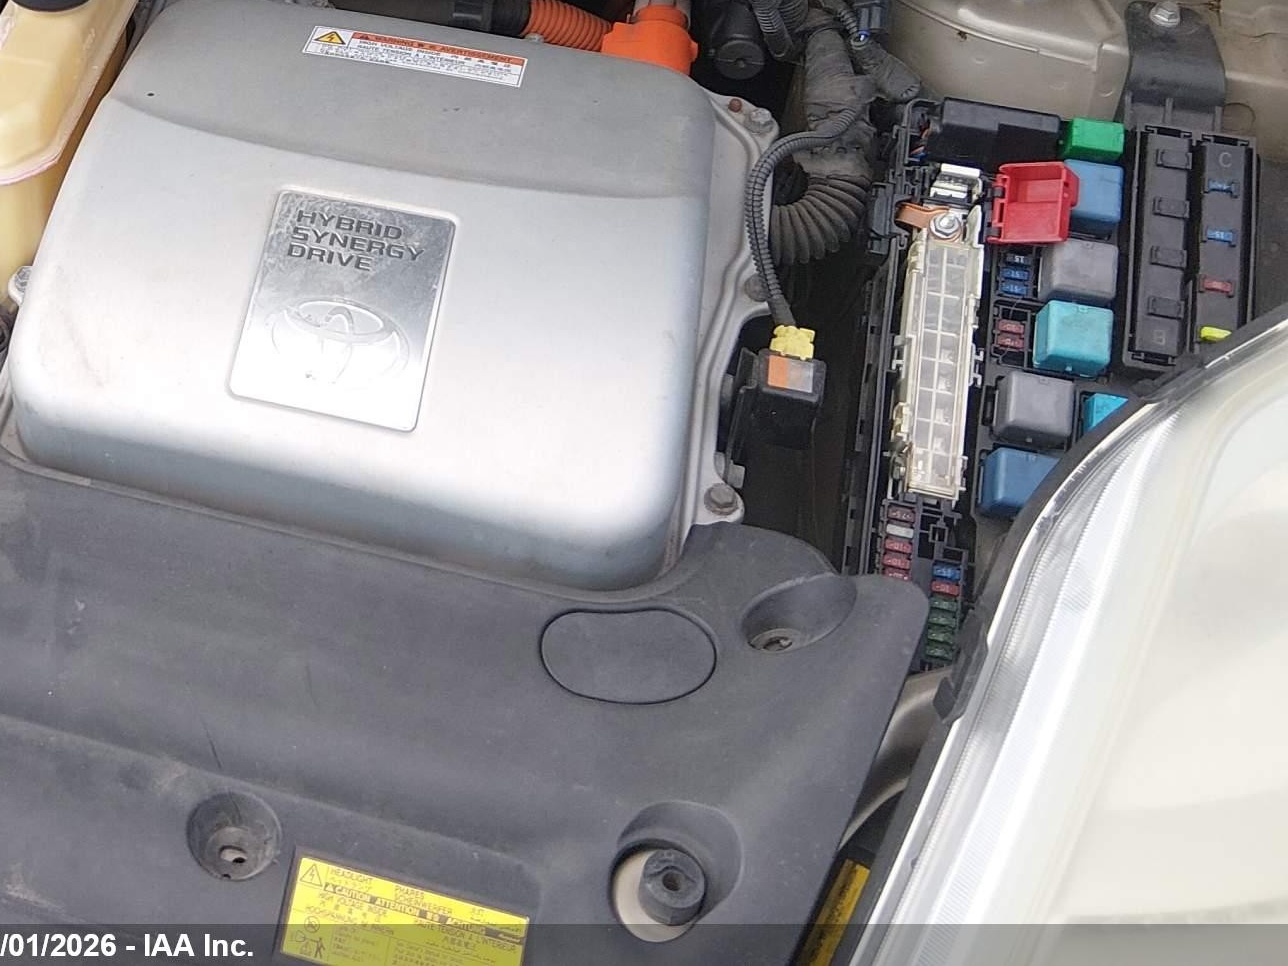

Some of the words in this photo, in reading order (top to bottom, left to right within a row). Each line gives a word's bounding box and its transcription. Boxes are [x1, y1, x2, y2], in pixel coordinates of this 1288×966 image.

[1218, 151, 1232, 169] C
[297, 209, 404, 240] HYBRID
[287, 242, 374, 272] DRIVE
[291, 225, 424, 261] SYNERGY
[329, 868, 372, 884] HEADLIGHT
[394, 885, 424, 898] PHARES
[334, 887, 371, 902] CAUTION
[375, 898, 420, 916] ATTENTION
